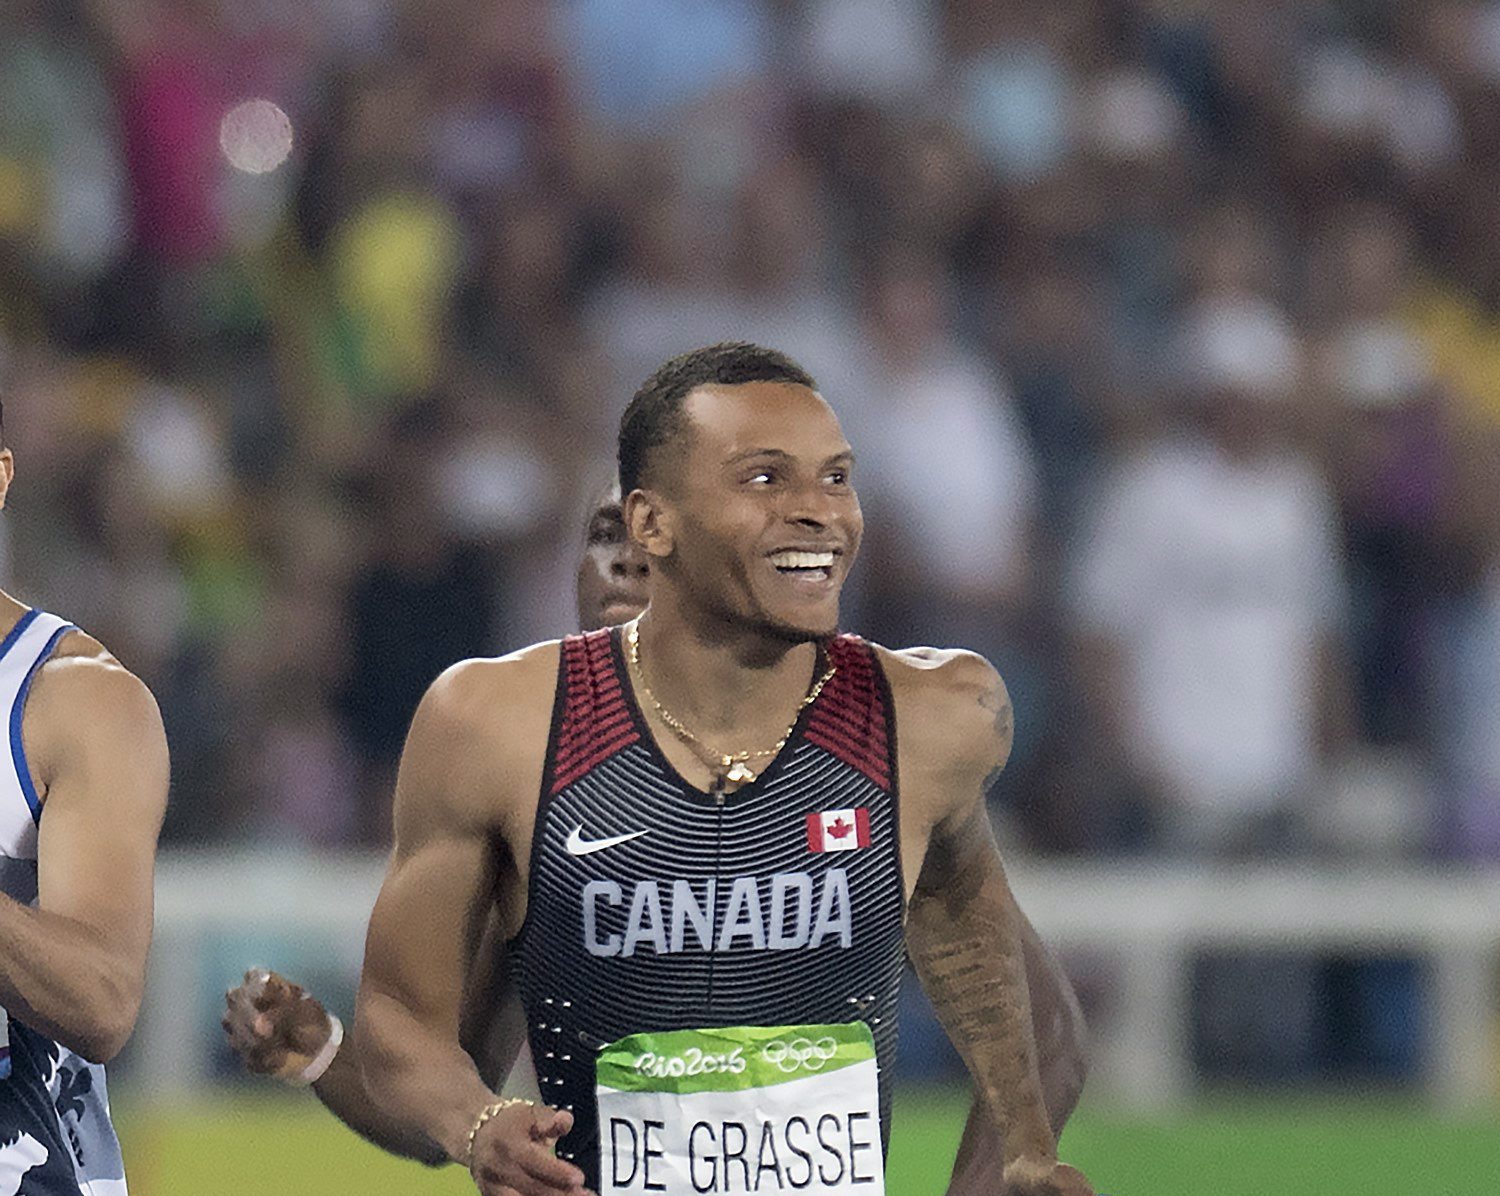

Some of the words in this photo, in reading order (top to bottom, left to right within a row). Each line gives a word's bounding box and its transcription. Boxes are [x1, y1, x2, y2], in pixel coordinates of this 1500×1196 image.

[582, 868, 853, 957] CANADA
[610, 1116, 667, 1192] DE
[689, 1111, 876, 1193] GRASSE
